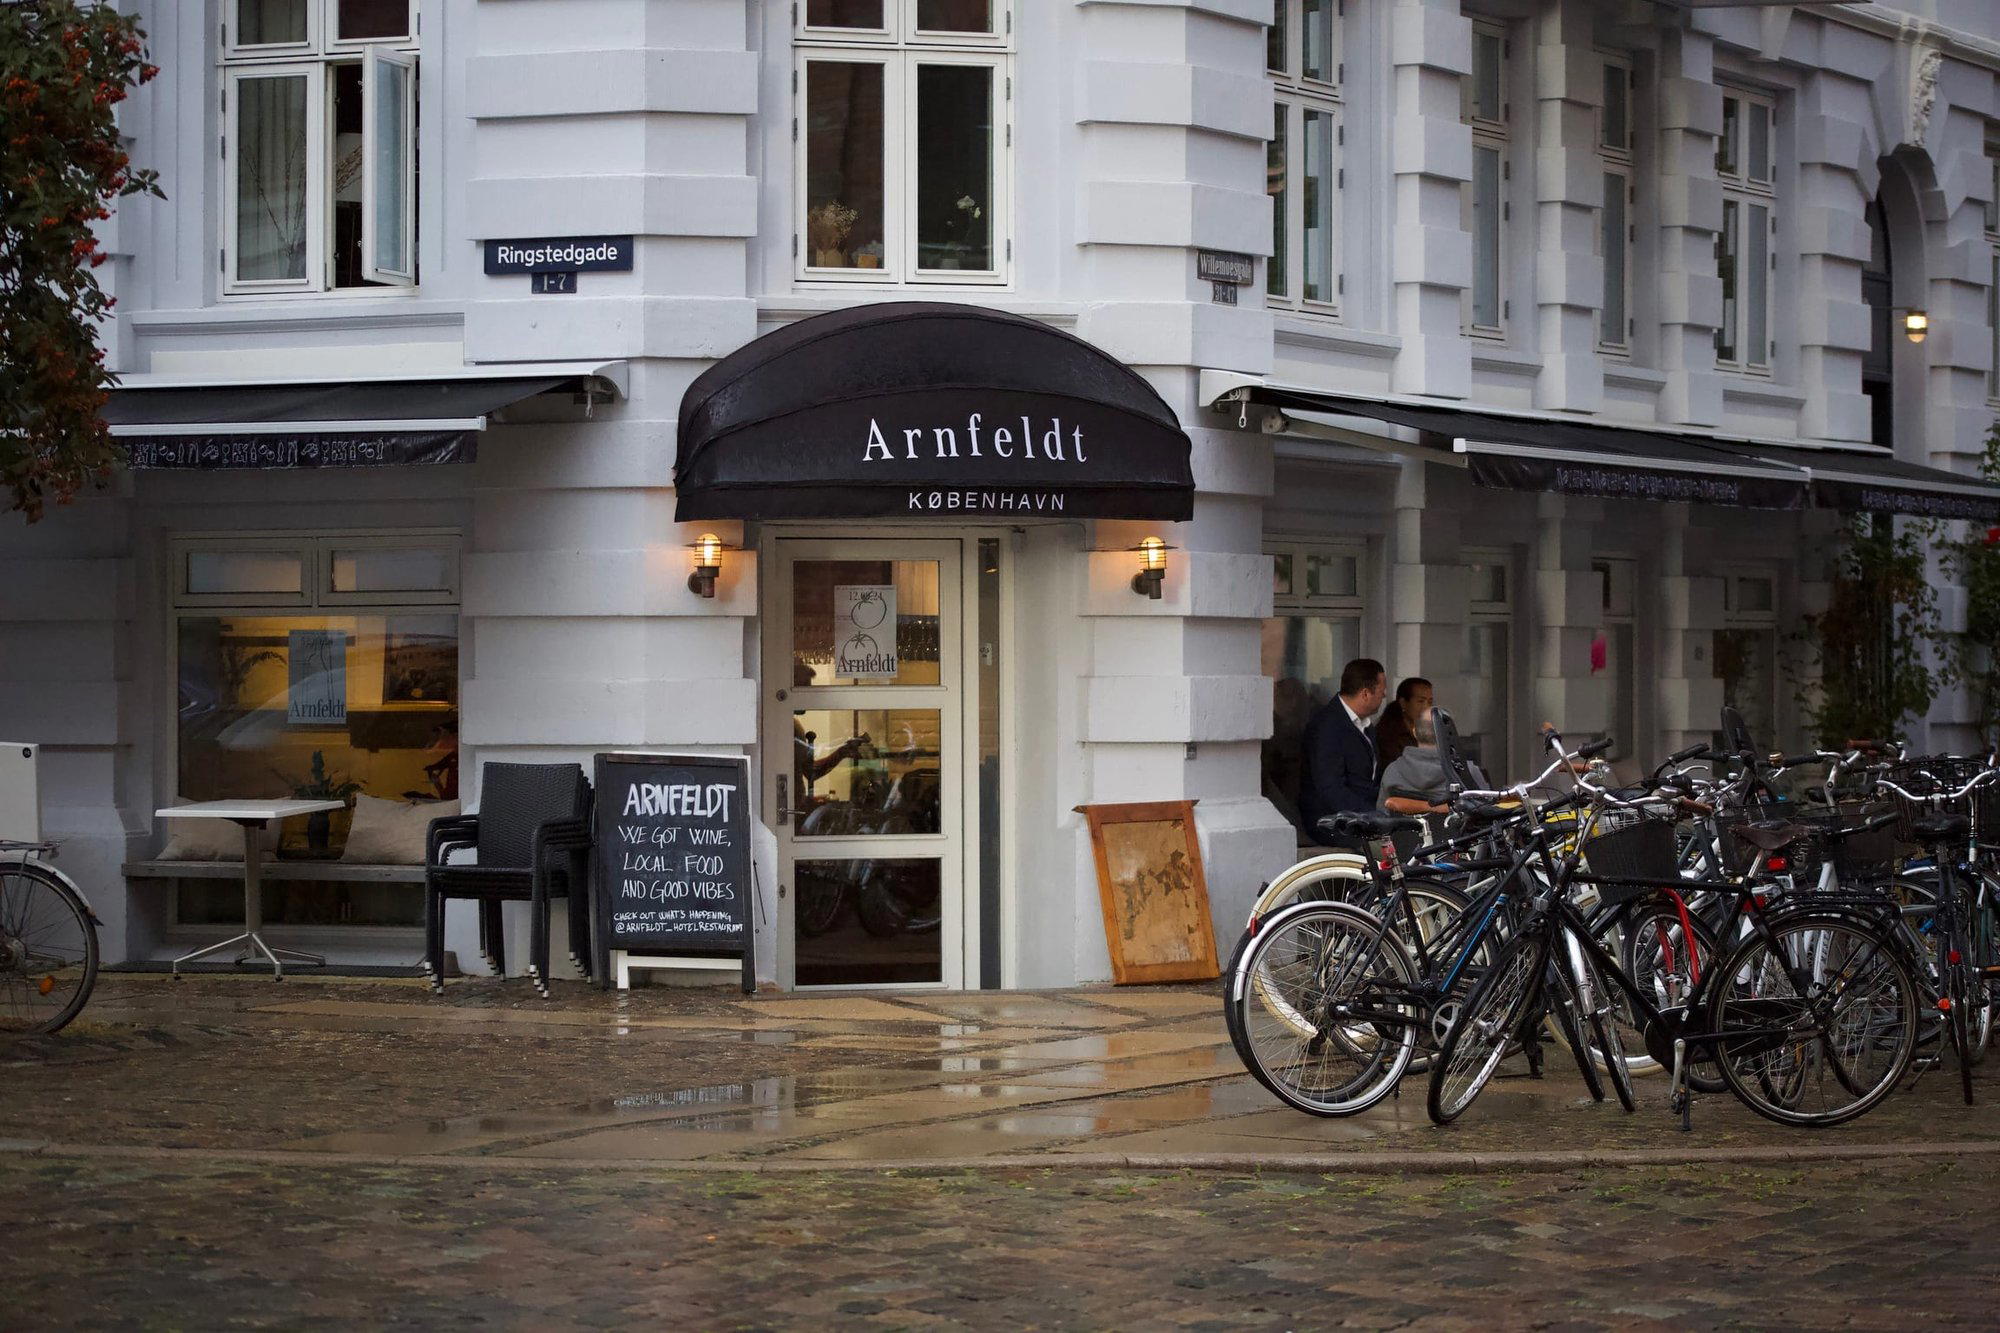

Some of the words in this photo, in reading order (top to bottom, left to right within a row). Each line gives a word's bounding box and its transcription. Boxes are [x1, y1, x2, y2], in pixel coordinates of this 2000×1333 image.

[497, 243, 618, 267] Ringstedgade
[542, 274, 566, 291] 1-7
[862, 413, 1087, 462] Arnfeldt
[908, 491, 1064, 511] KØBENHAVN
[836, 654, 896, 672] Arnfeldt
[290, 699, 345, 718] Arnfeldt
[622, 783, 737, 822] ARNFELDT
[618, 825, 647, 844] WE
[651, 826, 681, 849] GOT
[689, 828, 731, 847] WINE,
[623, 852, 673, 872] LOCAL
[685, 854, 723, 875] FOOD
[622, 879, 646, 899] AND
[650, 880, 689, 903] GOOD
[693, 881, 734, 900] VIBES
[613, 912, 637, 921] CHECK
[640, 911, 656, 920] OUT
[658, 910, 686, 920] WHAT'S
[689, 910, 731, 922] HAPPENING
